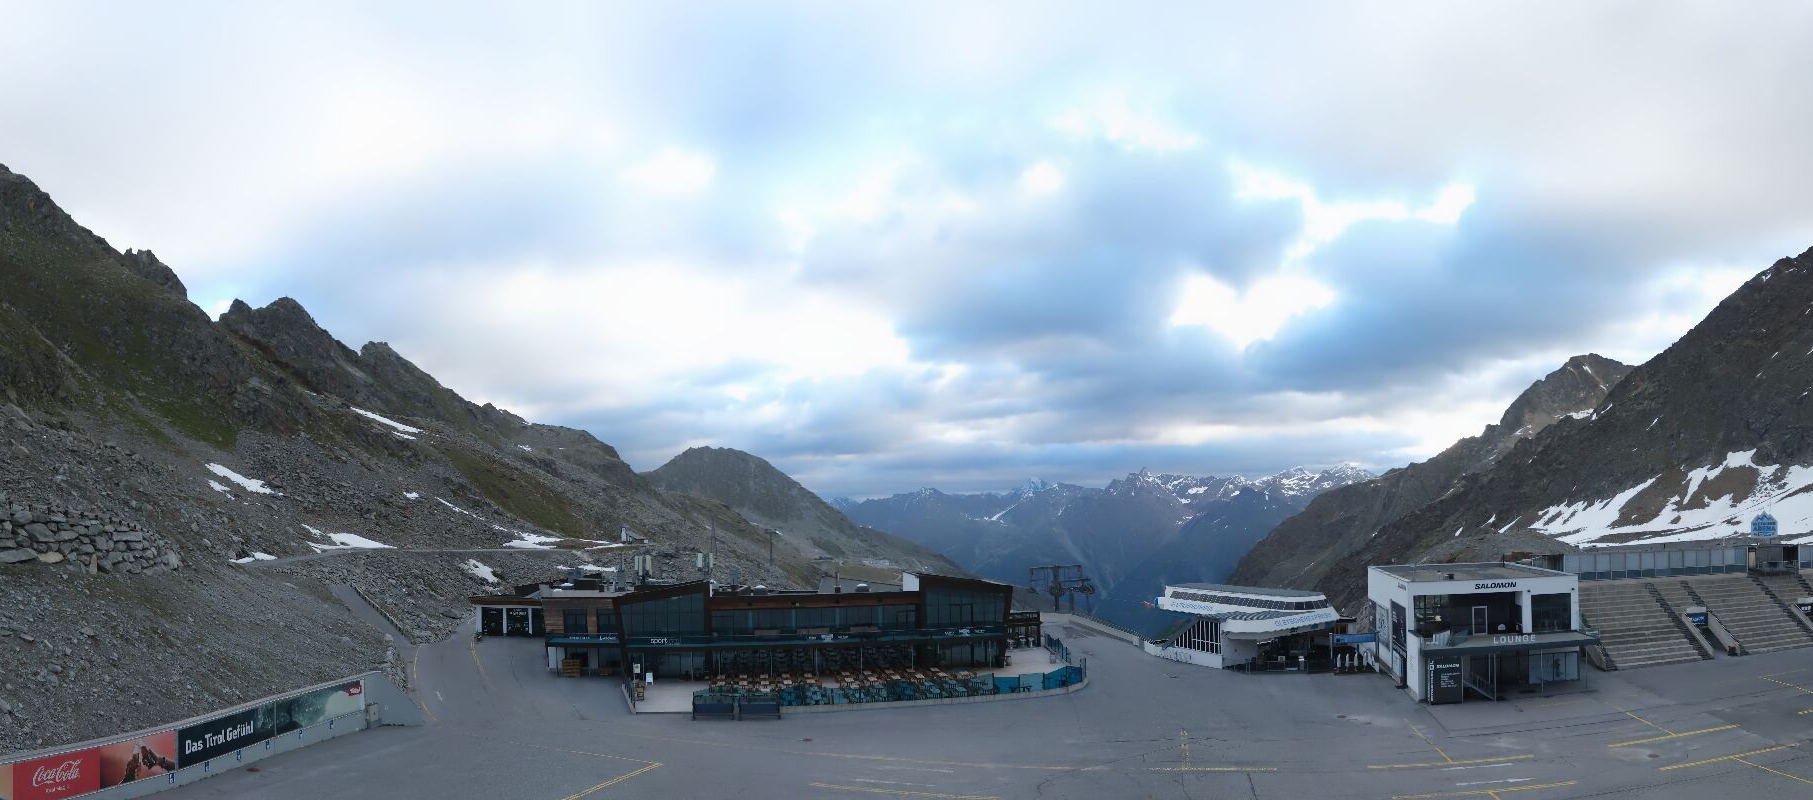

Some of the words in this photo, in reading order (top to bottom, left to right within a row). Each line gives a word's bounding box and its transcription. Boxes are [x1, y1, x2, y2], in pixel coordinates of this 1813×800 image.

[1475, 581, 1517, 590] SALOMON
[650, 637, 668, 645] sport
[1493, 634, 1536, 644] LOUNGE
[185, 739, 204, 755] Das
[205, 729, 225, 748] Tirol
[227, 720, 254, 741] Gefühl
[33, 759, 82, 787] Coca-Cola
